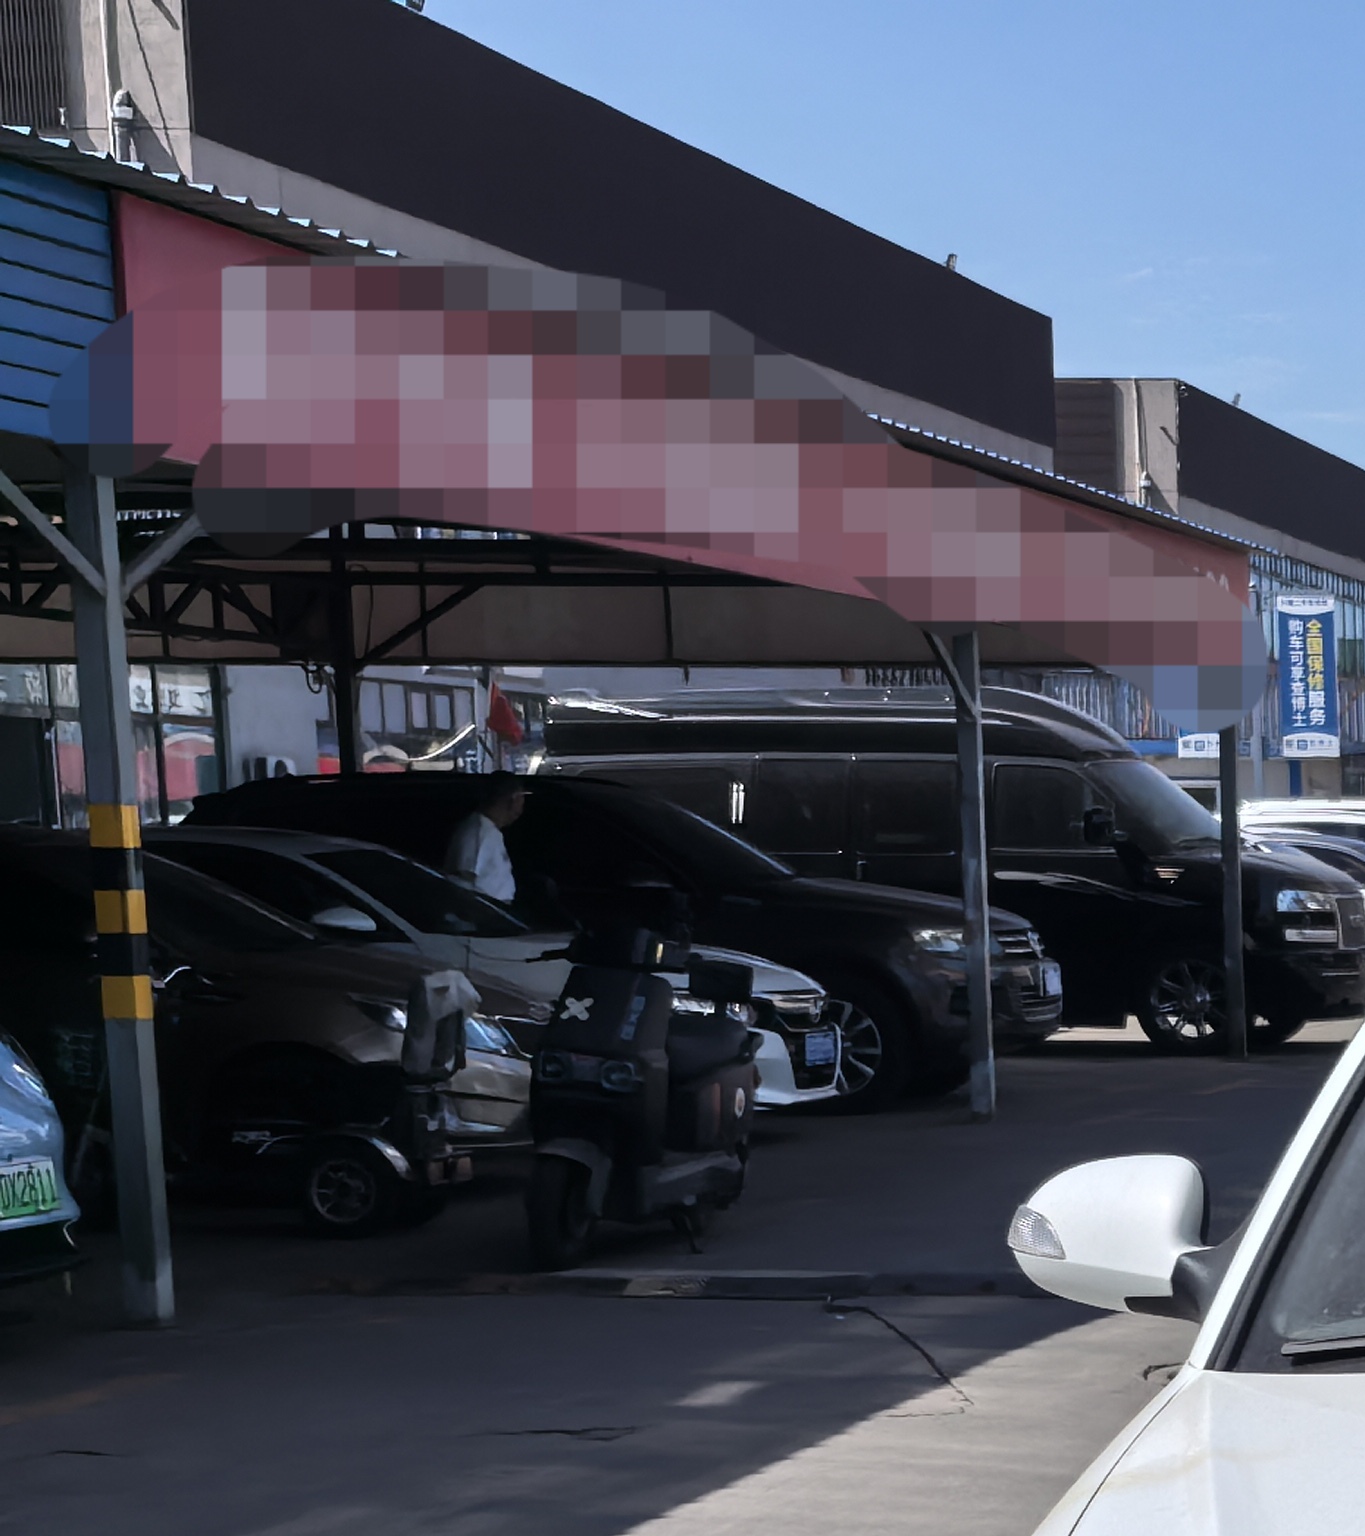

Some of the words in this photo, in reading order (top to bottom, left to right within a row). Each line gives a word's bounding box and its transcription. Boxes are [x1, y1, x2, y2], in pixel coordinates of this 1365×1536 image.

[1287, 617, 1307, 727] 购车可享查博士
[1306, 618, 1326, 726] 全国保修服务
